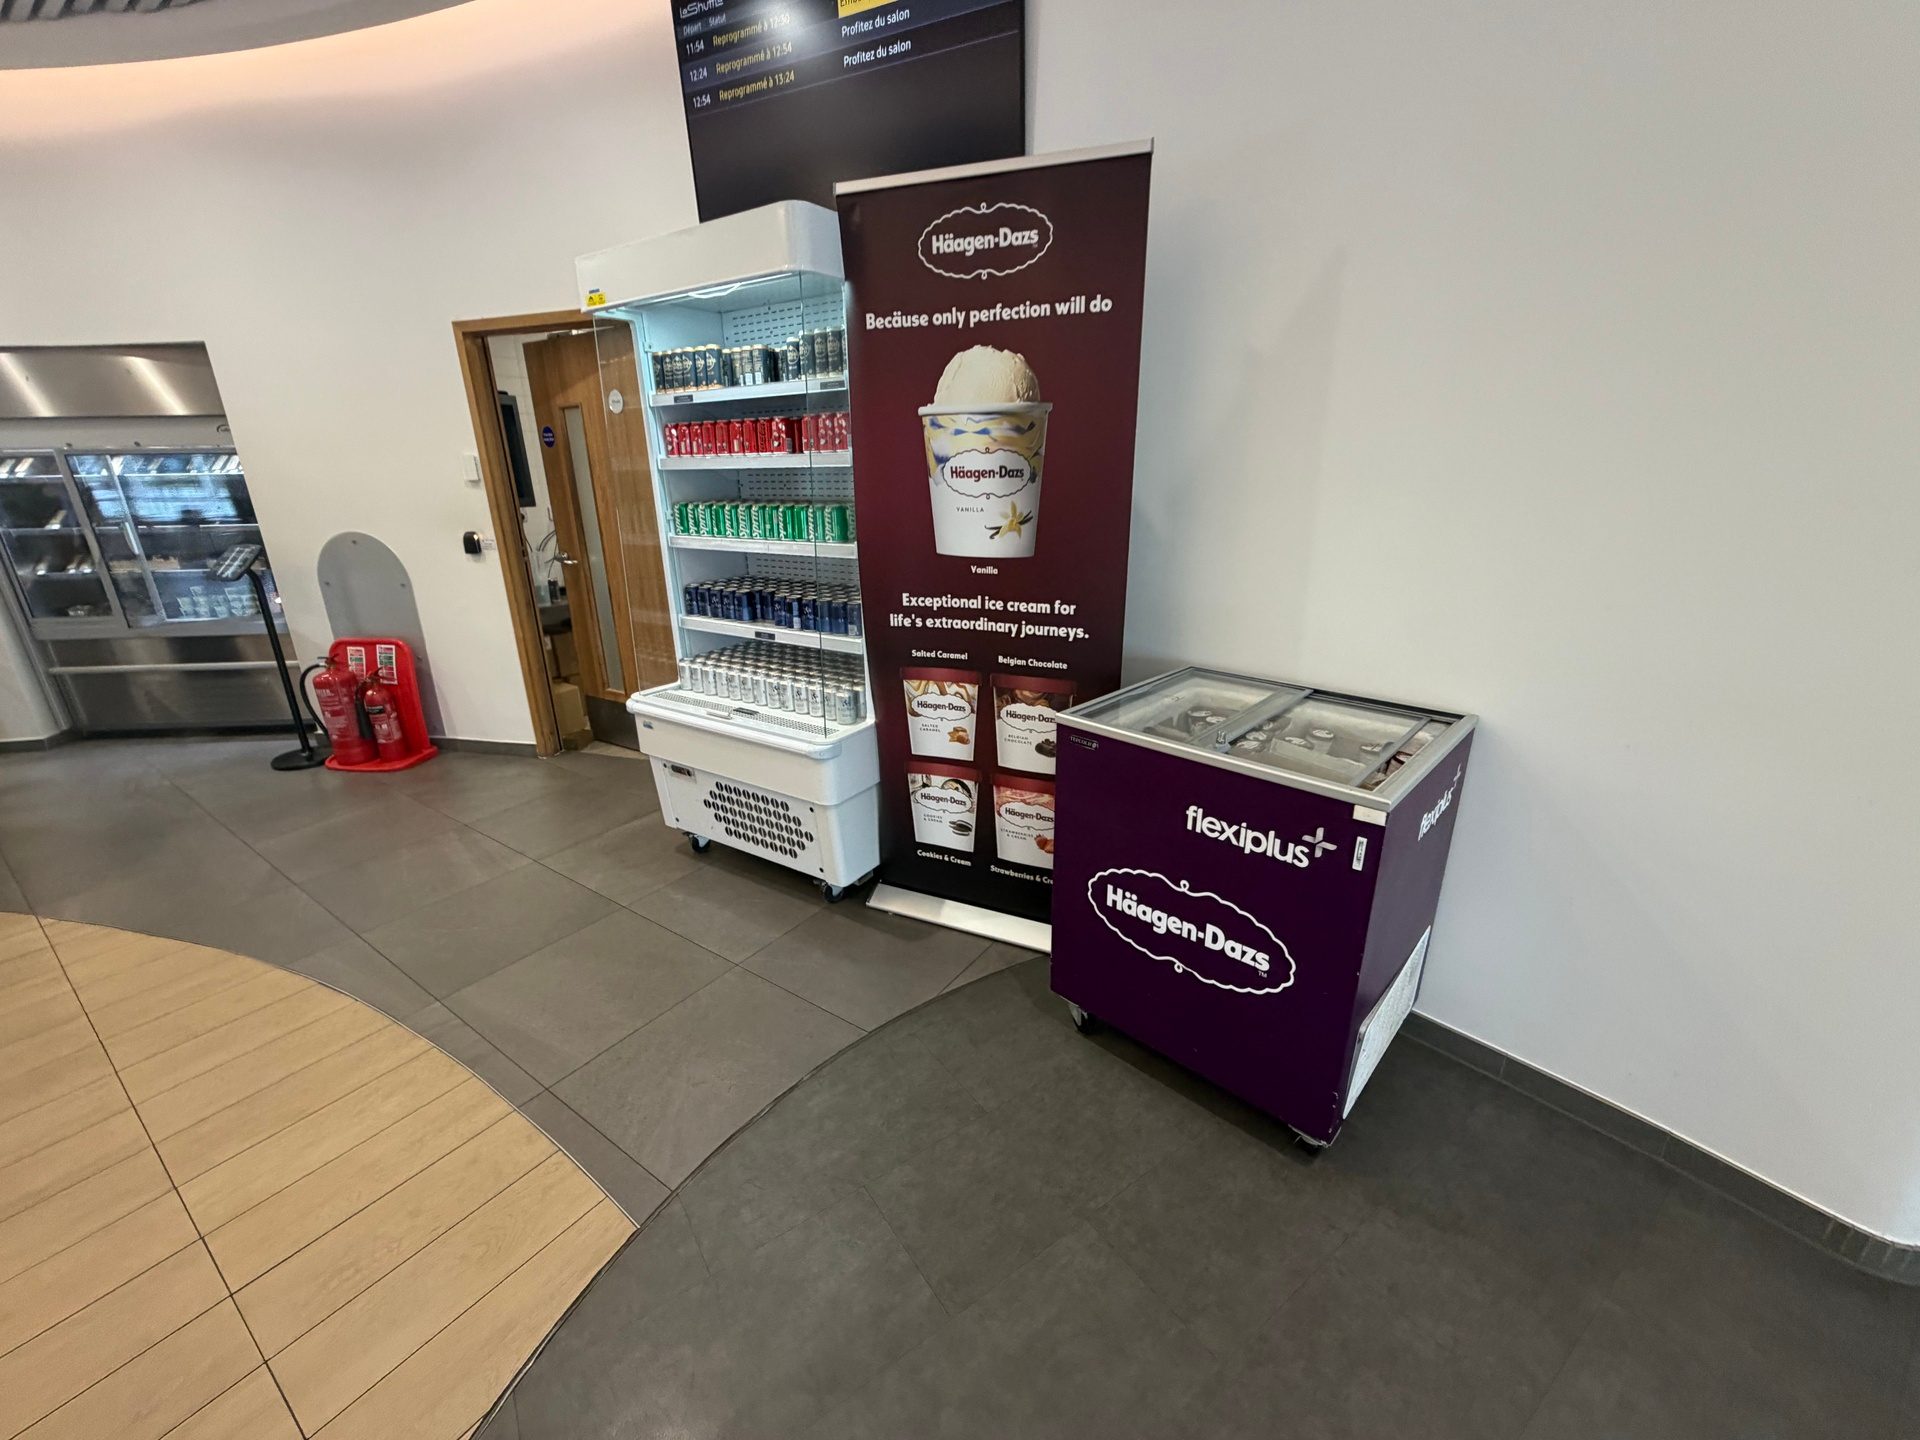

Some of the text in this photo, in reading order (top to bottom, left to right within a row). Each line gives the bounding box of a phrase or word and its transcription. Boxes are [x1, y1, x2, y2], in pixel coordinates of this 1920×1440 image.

[841, 8, 910, 38] Profitez du salon
[686, 39, 704, 55] 11:54
[713, 22, 762, 47] Reprogrammé
[763, 20, 768, 31] à
[689, 41, 792, 82] 12:24 Reprogrammé à 12:54
[843, 40, 912, 68] Profitez du salon
[692, 69, 795, 109] 12:54 Reprogrammé à 13:24
[931, 226, 1039, 257] Häagen-Dazs
[865, 294, 1113, 330] Becäuse only perfection will do
[949, 465, 1025, 482] Häagen-Dazs
[970, 565, 999, 575] Vanilla
[902, 593, 1076, 615] Exceptional ice cream for
[889, 613, 1090, 642] life's extraordinary journeys.
[911, 649, 968, 660] Salted Caramel
[998, 655, 1068, 670] Belgian Chocolate
[916, 700, 966, 713] Häagen-Dazs
[920, 792, 967, 806] Häagen-Dazs
[1185, 805, 1310, 868] flexiplus
[917, 850, 943, 861] Cookies
[950, 855, 972, 867] Cream
[990, 864, 1034, 881] Strawberries
[1035, 874, 1041, 882] &
[1106, 883, 1270, 972] Häagen-Dazs
